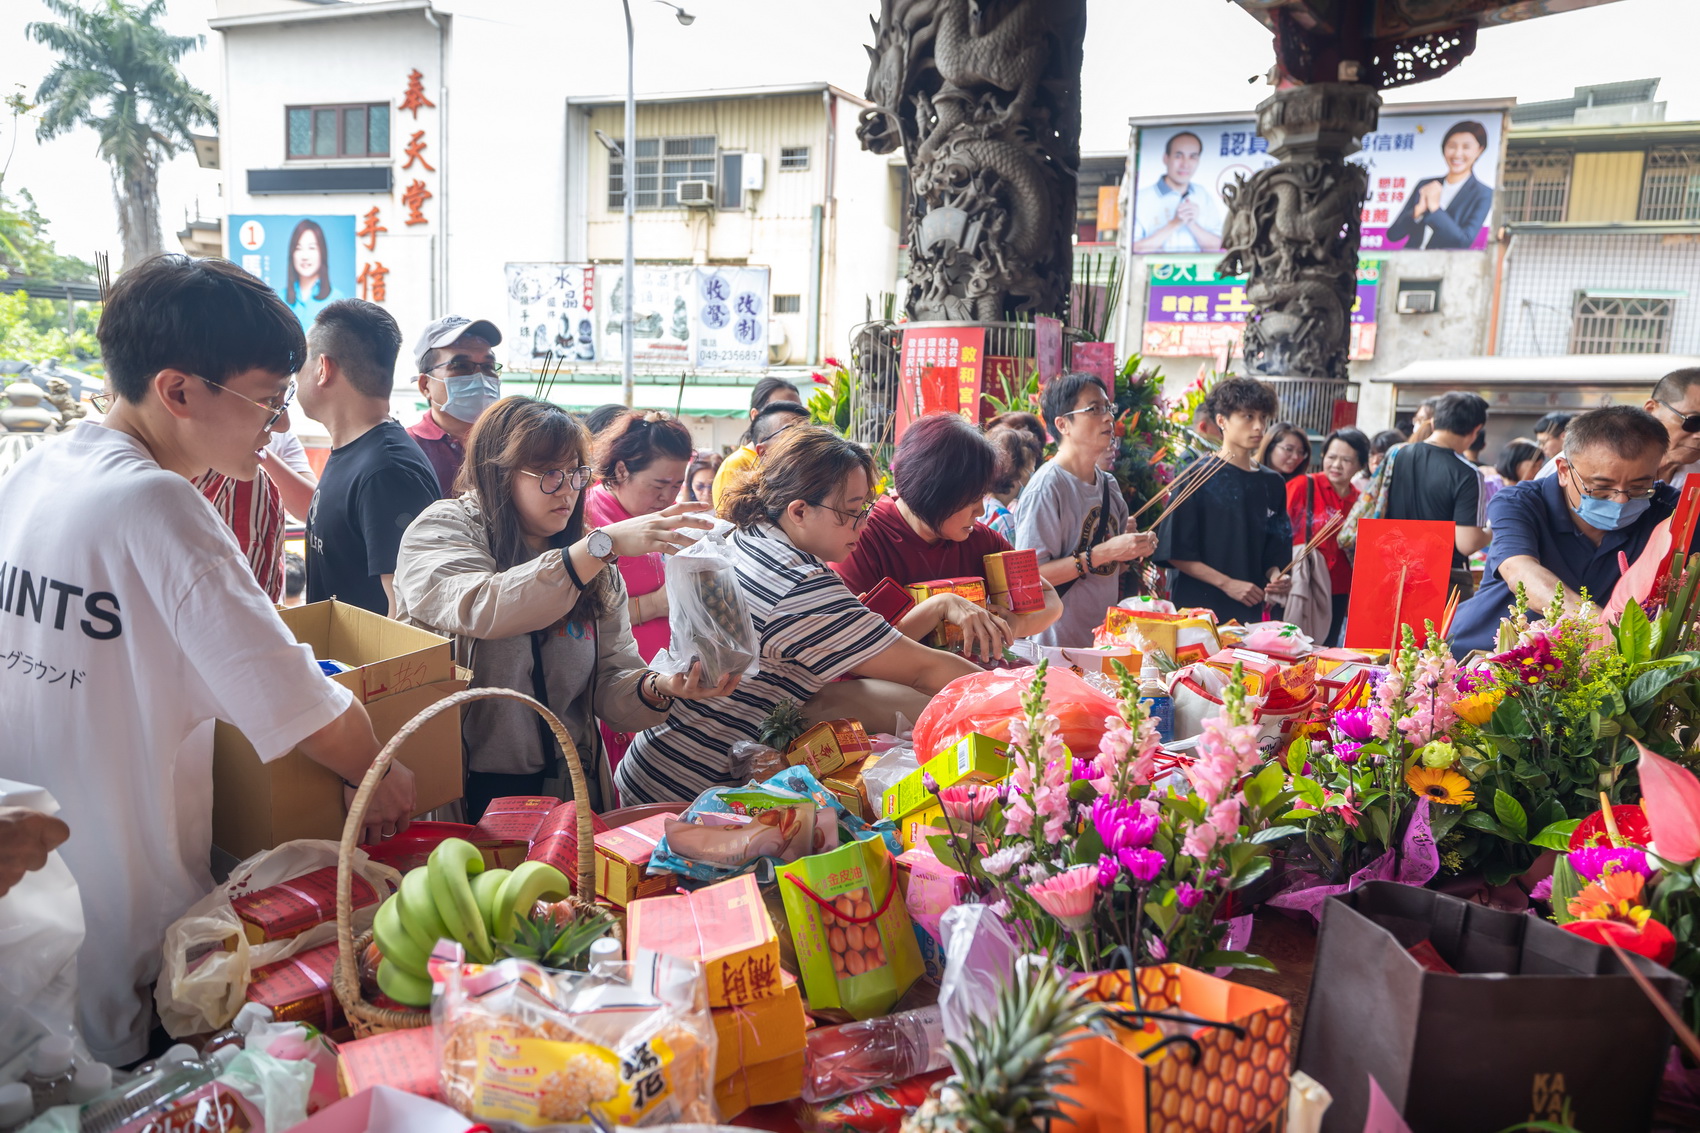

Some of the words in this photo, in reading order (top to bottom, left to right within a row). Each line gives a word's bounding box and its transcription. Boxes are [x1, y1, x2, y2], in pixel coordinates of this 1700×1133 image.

[398, 68, 435, 226] 奉天堂
[247, 226, 257, 245] 1
[356, 206, 390, 302] 手信
[553, 268, 578, 309] 水晶
[706, 279, 726, 328] 收驚
[699, 350, 763, 361] 049-2356897
[0, 561, 122, 640] INTS
[827, 866, 863, 887] 金皮油
